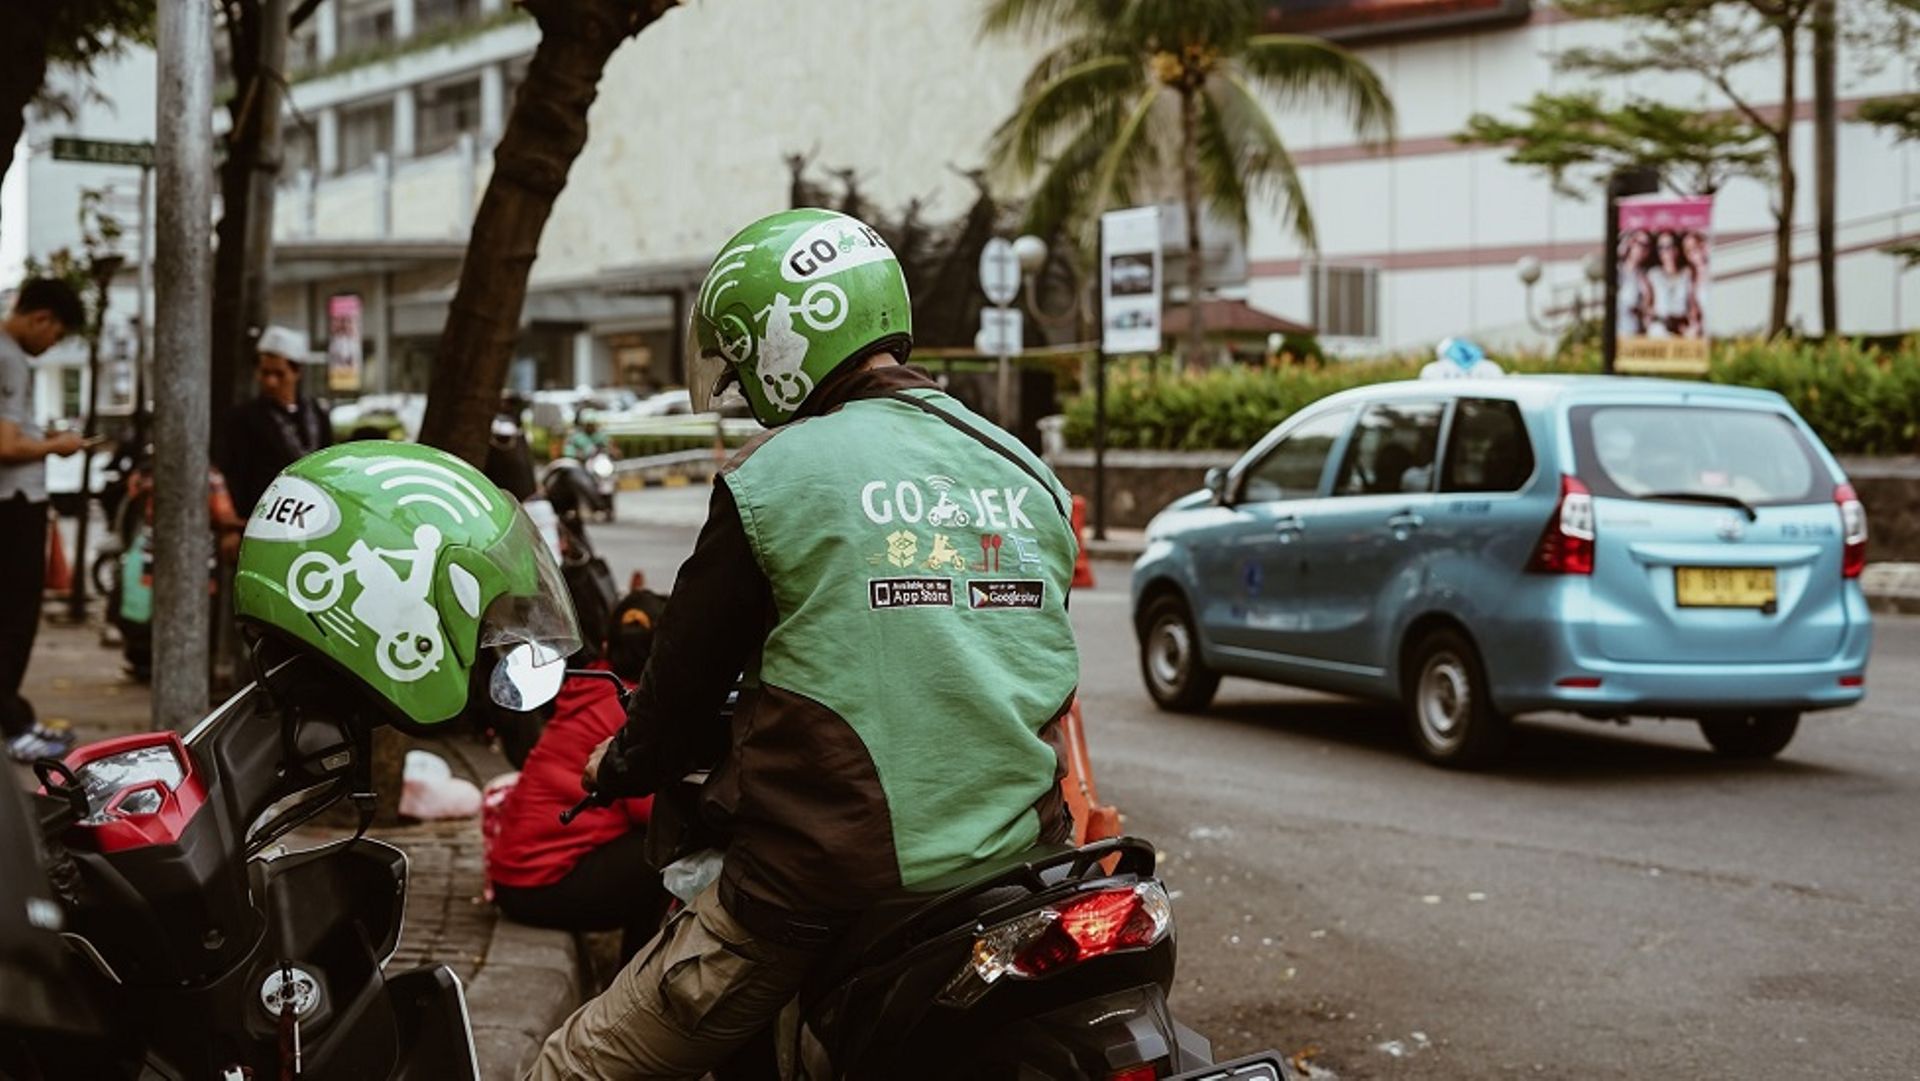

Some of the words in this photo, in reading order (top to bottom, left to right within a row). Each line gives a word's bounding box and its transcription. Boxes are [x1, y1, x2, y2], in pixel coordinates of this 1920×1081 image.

[790, 239, 837, 276] GO
[858, 227, 886, 248] JE
[266, 496, 316, 529] JEK
[861, 480, 923, 525] GO
[969, 486, 1035, 529] JEK
[893, 590, 919, 604] App
[921, 588, 949, 602] Store
